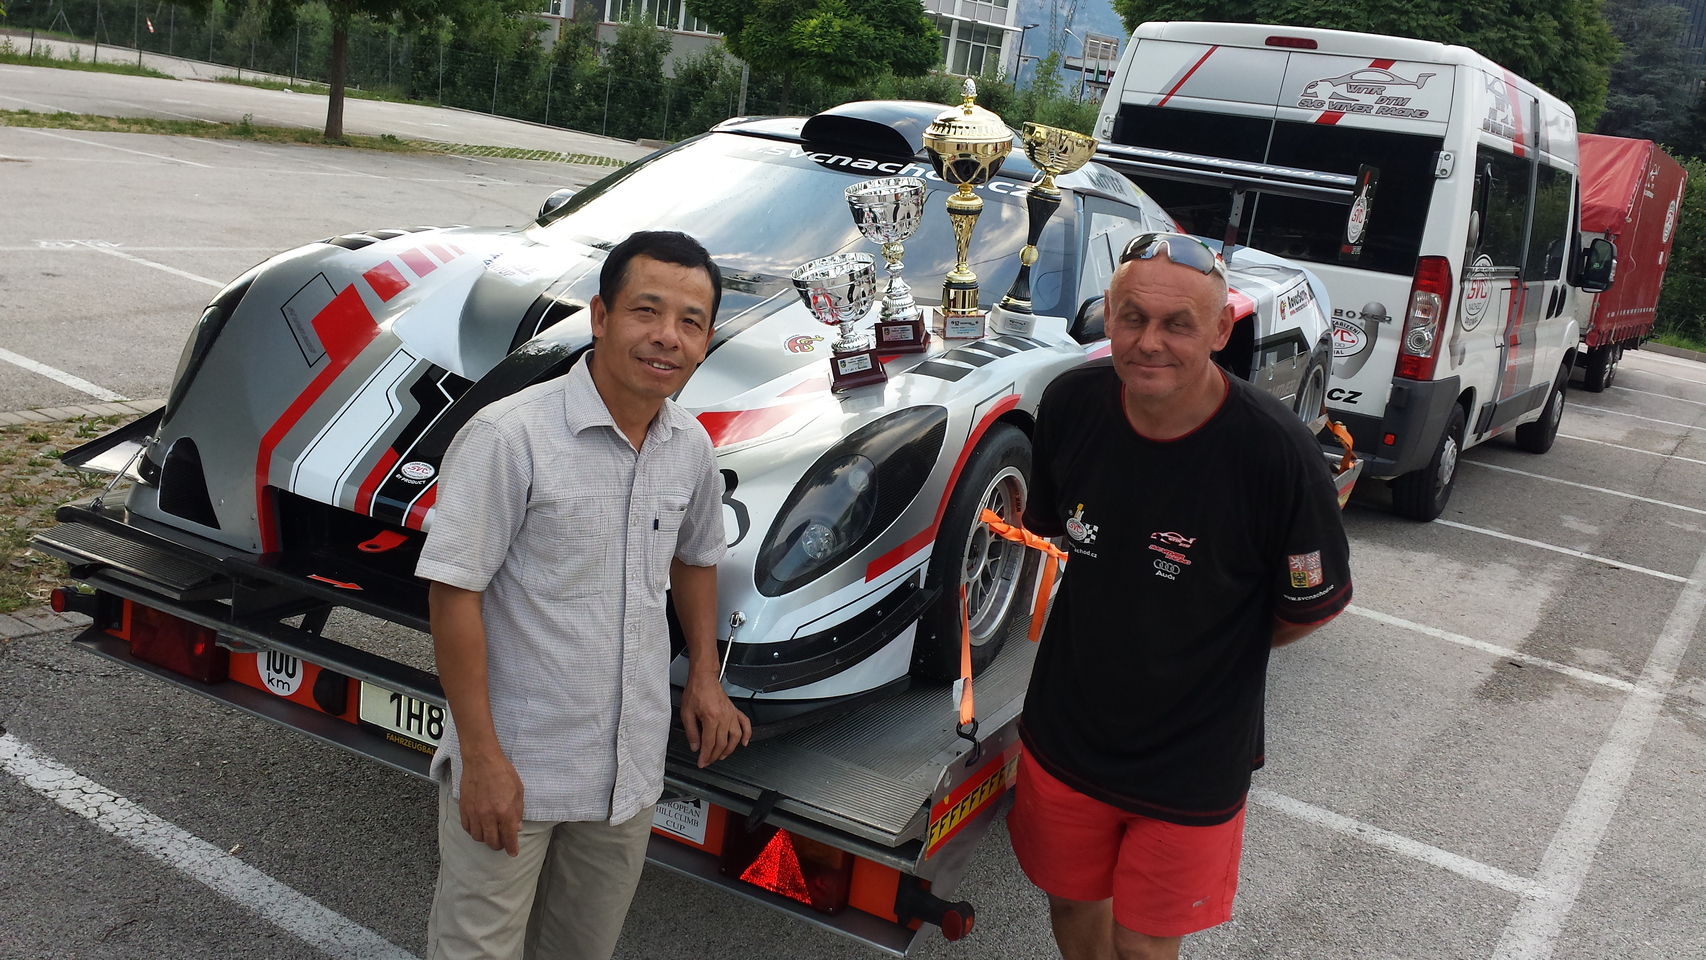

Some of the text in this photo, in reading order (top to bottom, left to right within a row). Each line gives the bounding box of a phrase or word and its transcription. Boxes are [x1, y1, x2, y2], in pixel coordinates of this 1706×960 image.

[1298, 98, 1429, 119] SVC VITVER RACING
[1375, 96, 1411, 106] DTM
[1467, 279, 1488, 299] SVC
[1334, 308, 1393, 325] BOXER
[266, 650, 297, 679] 100
[267, 672, 291, 692] km
[655, 805, 699, 828] HILL CLIMB
[665, 819, 686, 831] CUP
